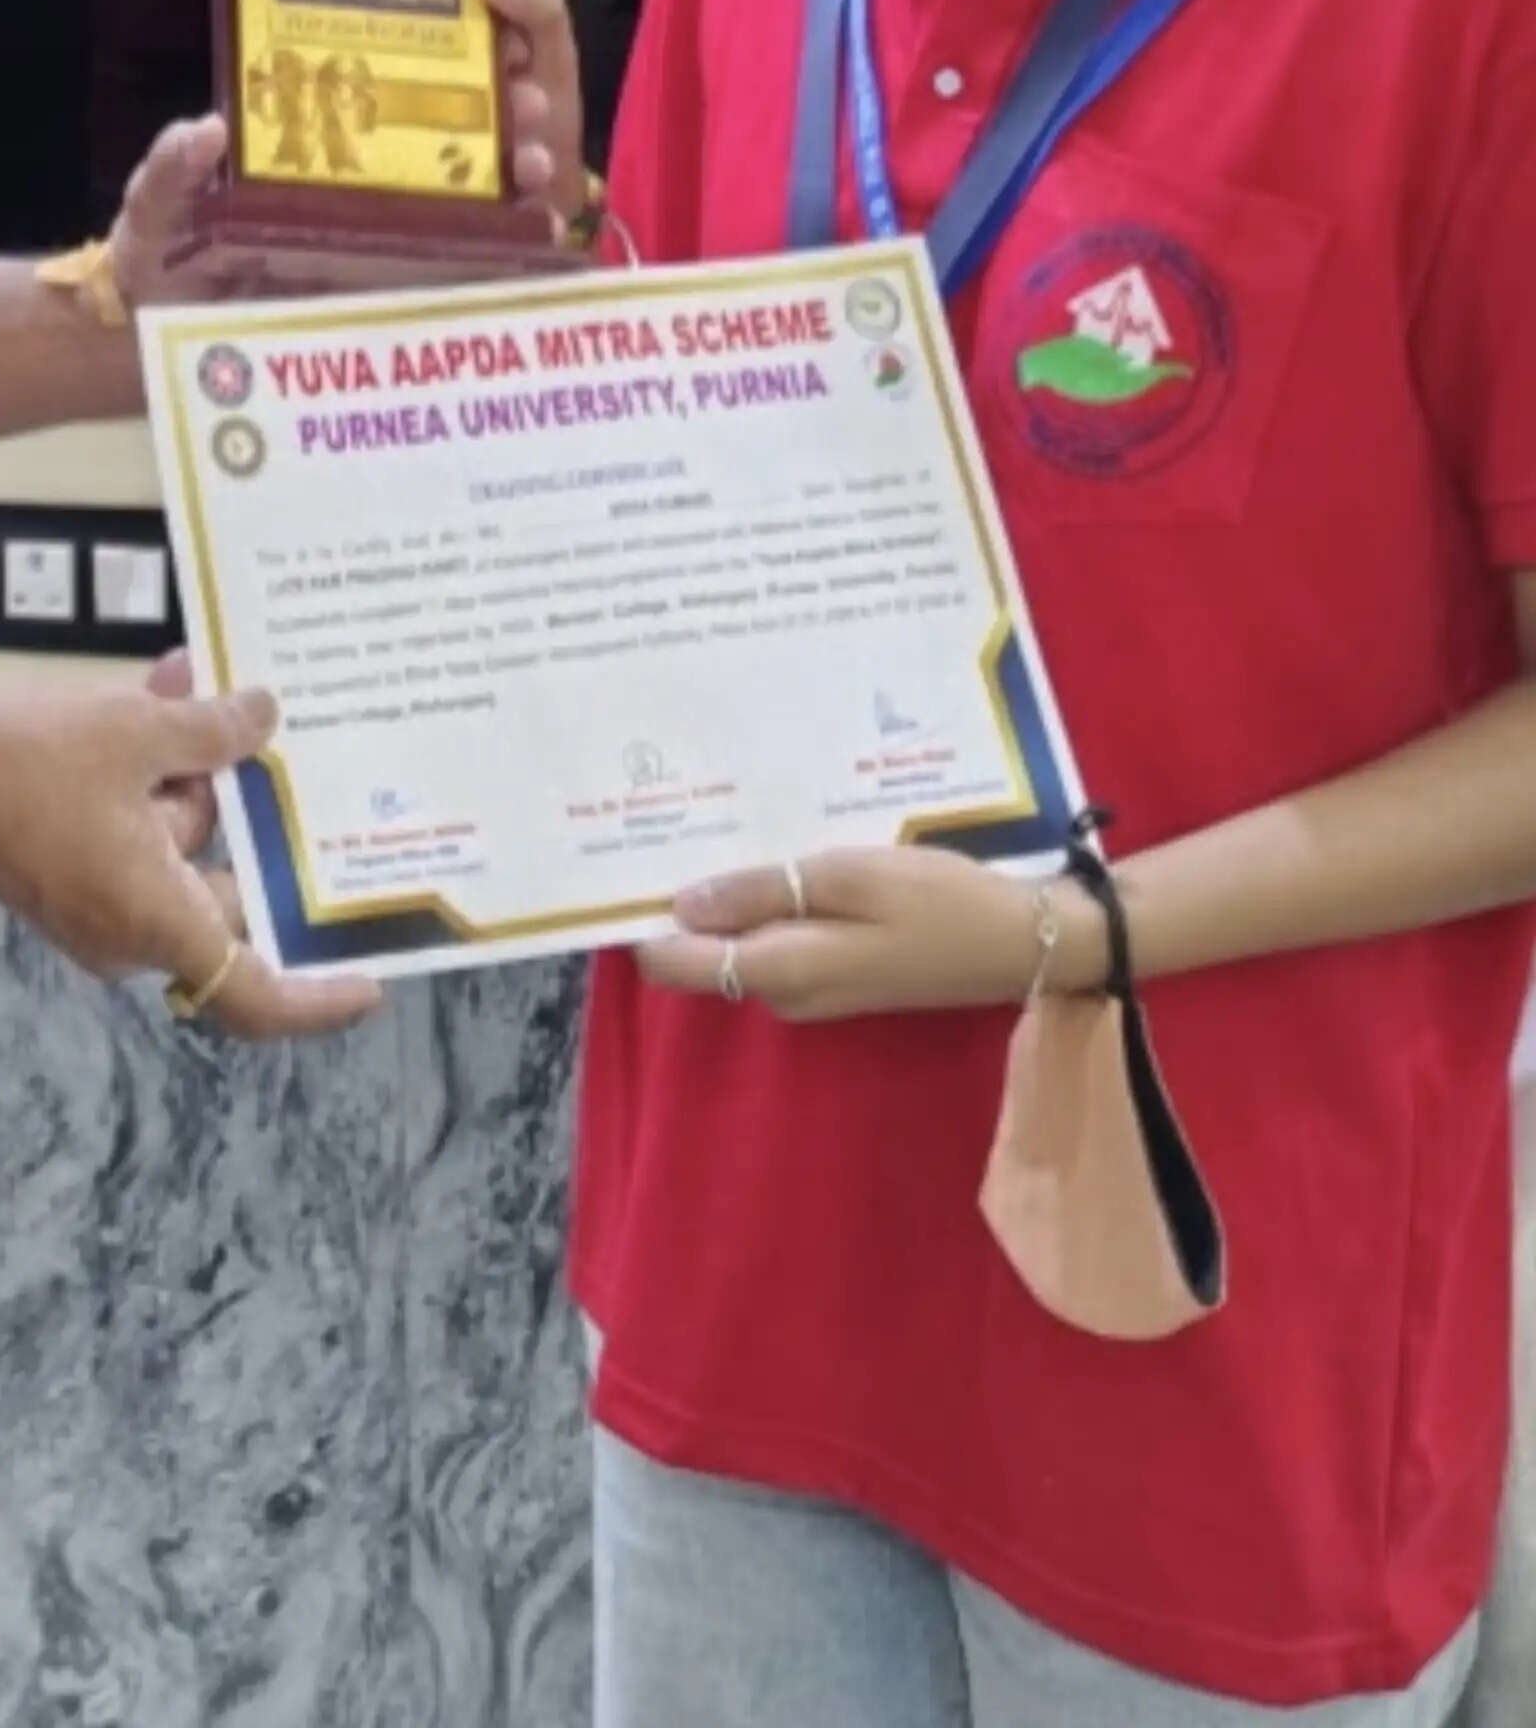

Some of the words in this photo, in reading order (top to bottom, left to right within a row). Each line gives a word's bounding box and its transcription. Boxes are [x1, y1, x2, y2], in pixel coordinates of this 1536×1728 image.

[265, 349, 380, 398] YUVA
[391, 331, 525, 387] AAPDA
[535, 319, 662, 369] MITRA
[671, 299, 833, 357] SCHEME
[298, 403, 449, 455] PURNEA
[460, 375, 689, 438] UNIVERSITY,
[691, 361, 828, 410] PURNIA
